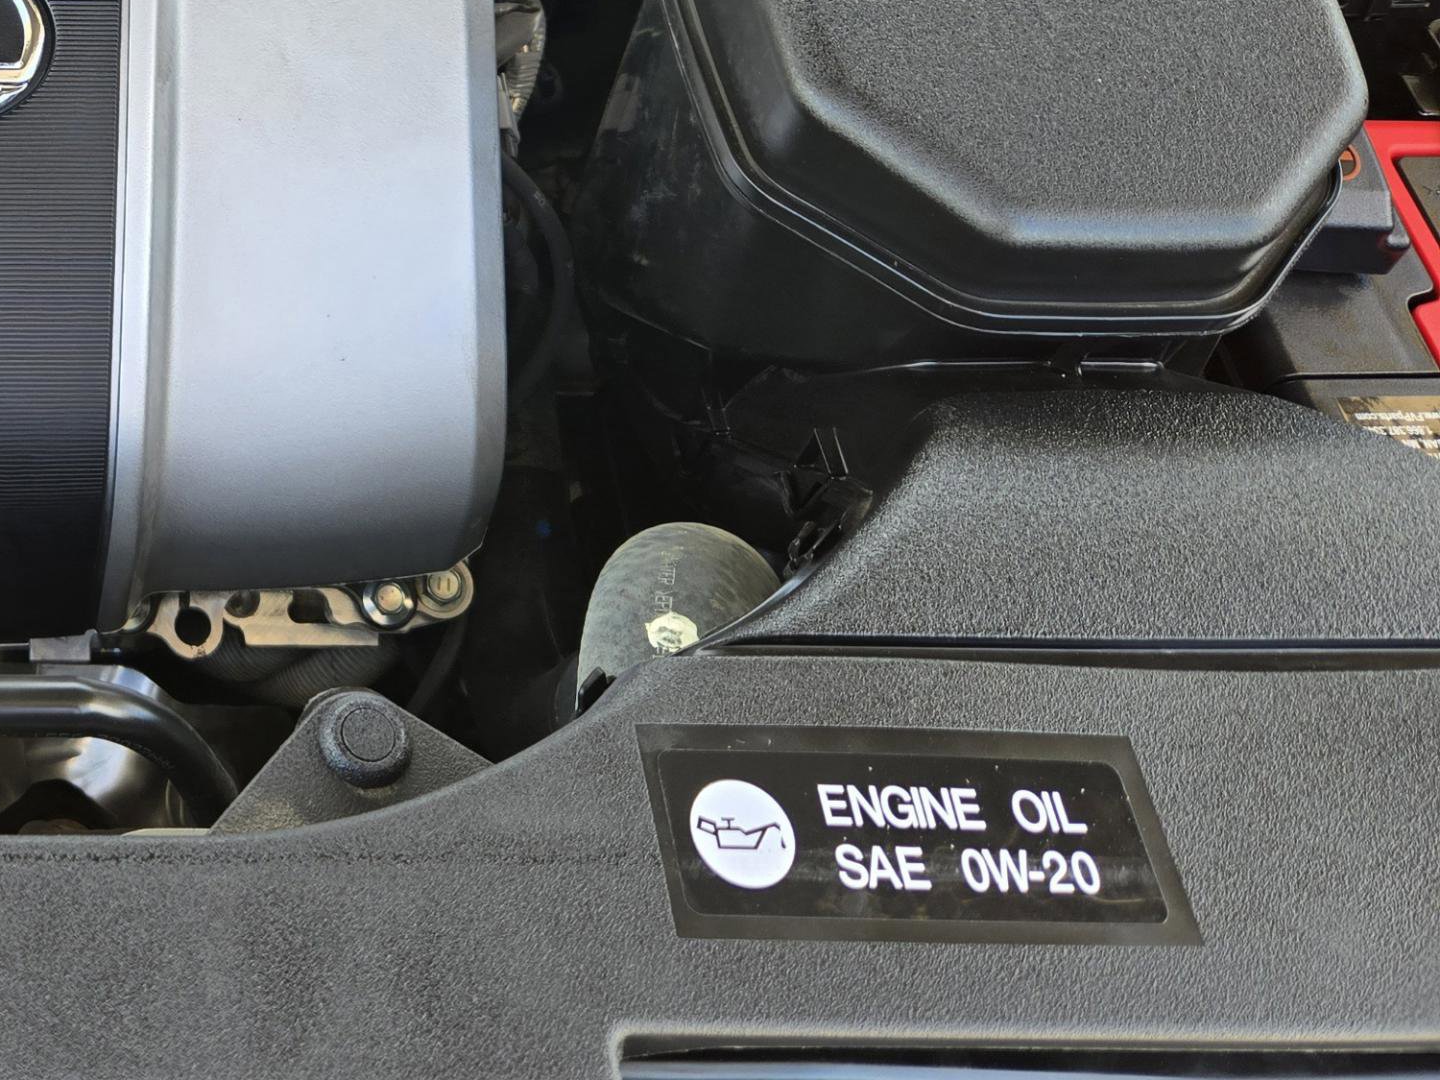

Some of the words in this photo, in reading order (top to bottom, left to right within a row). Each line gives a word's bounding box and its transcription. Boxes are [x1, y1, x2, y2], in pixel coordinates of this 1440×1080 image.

[817, 784, 987, 831] ENGINE
[1011, 789, 1088, 834] OIL
[835, 843, 932, 891] SAE
[961, 848, 1101, 895] 0W-20
